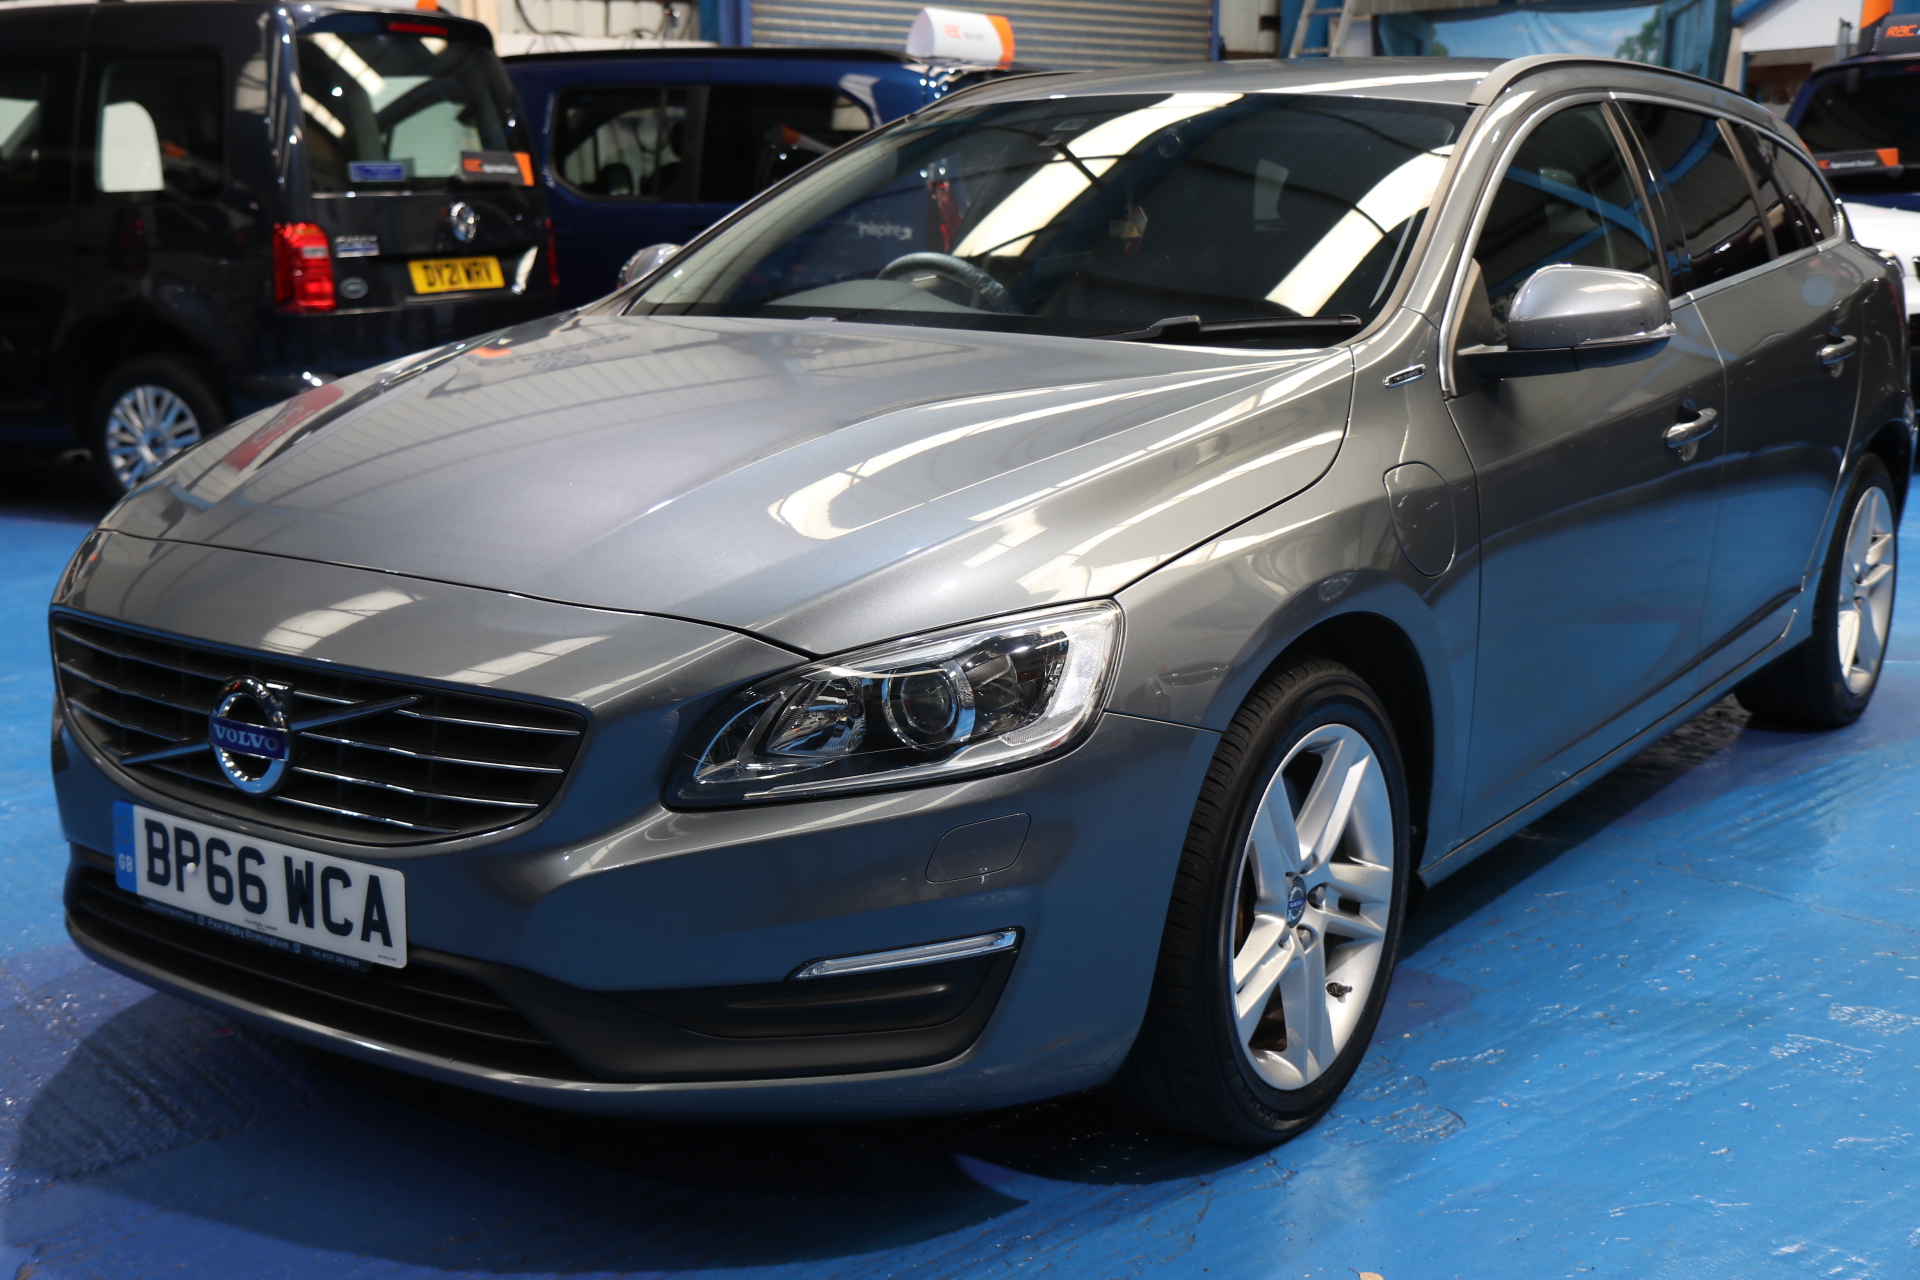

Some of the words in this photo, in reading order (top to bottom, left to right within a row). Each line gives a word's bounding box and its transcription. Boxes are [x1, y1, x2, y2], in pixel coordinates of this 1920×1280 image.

[213, 723, 280, 752] VOLVO
[118, 853, 133, 874] GB
[144, 817, 268, 915] BP66
[283, 854, 393, 948] WCA
[207, 917, 224, 930] Paul
[224, 922, 244, 938] Rigby
[245, 928, 289, 950] Birmingham
